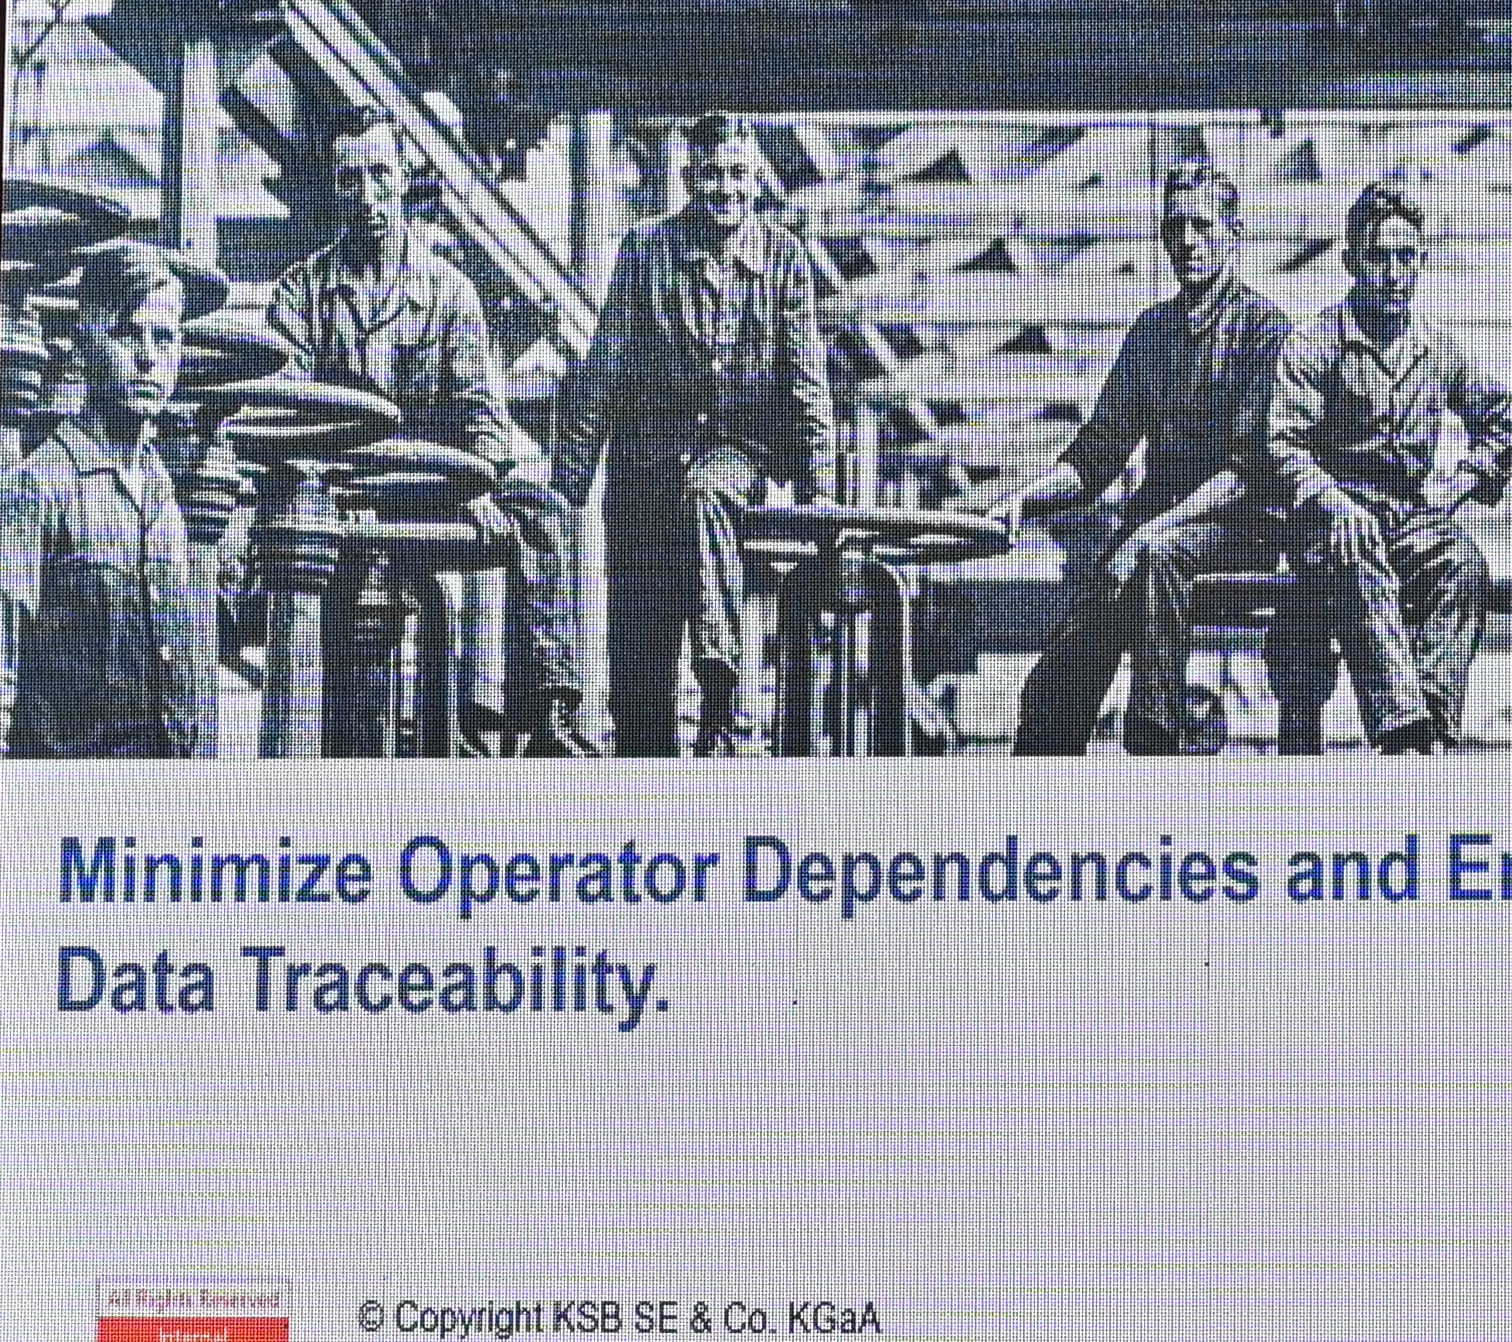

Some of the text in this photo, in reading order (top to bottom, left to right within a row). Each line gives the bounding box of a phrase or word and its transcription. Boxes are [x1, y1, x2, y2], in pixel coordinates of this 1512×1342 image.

[60, 836, 373, 905] Minimize
[398, 834, 720, 921] Operator
[743, 834, 1261, 921] Dependencies
[1286, 833, 1420, 903] and
[57, 945, 669, 1033] Data Traceability.
[396, 1298, 544, 1337] Copyright
[552, 1297, 624, 1333] KSB
[634, 1297, 678, 1333] SE
[688, 1297, 714, 1333] &
[724, 1297, 778, 1333] Co.
[788, 1297, 884, 1333] KGaA
